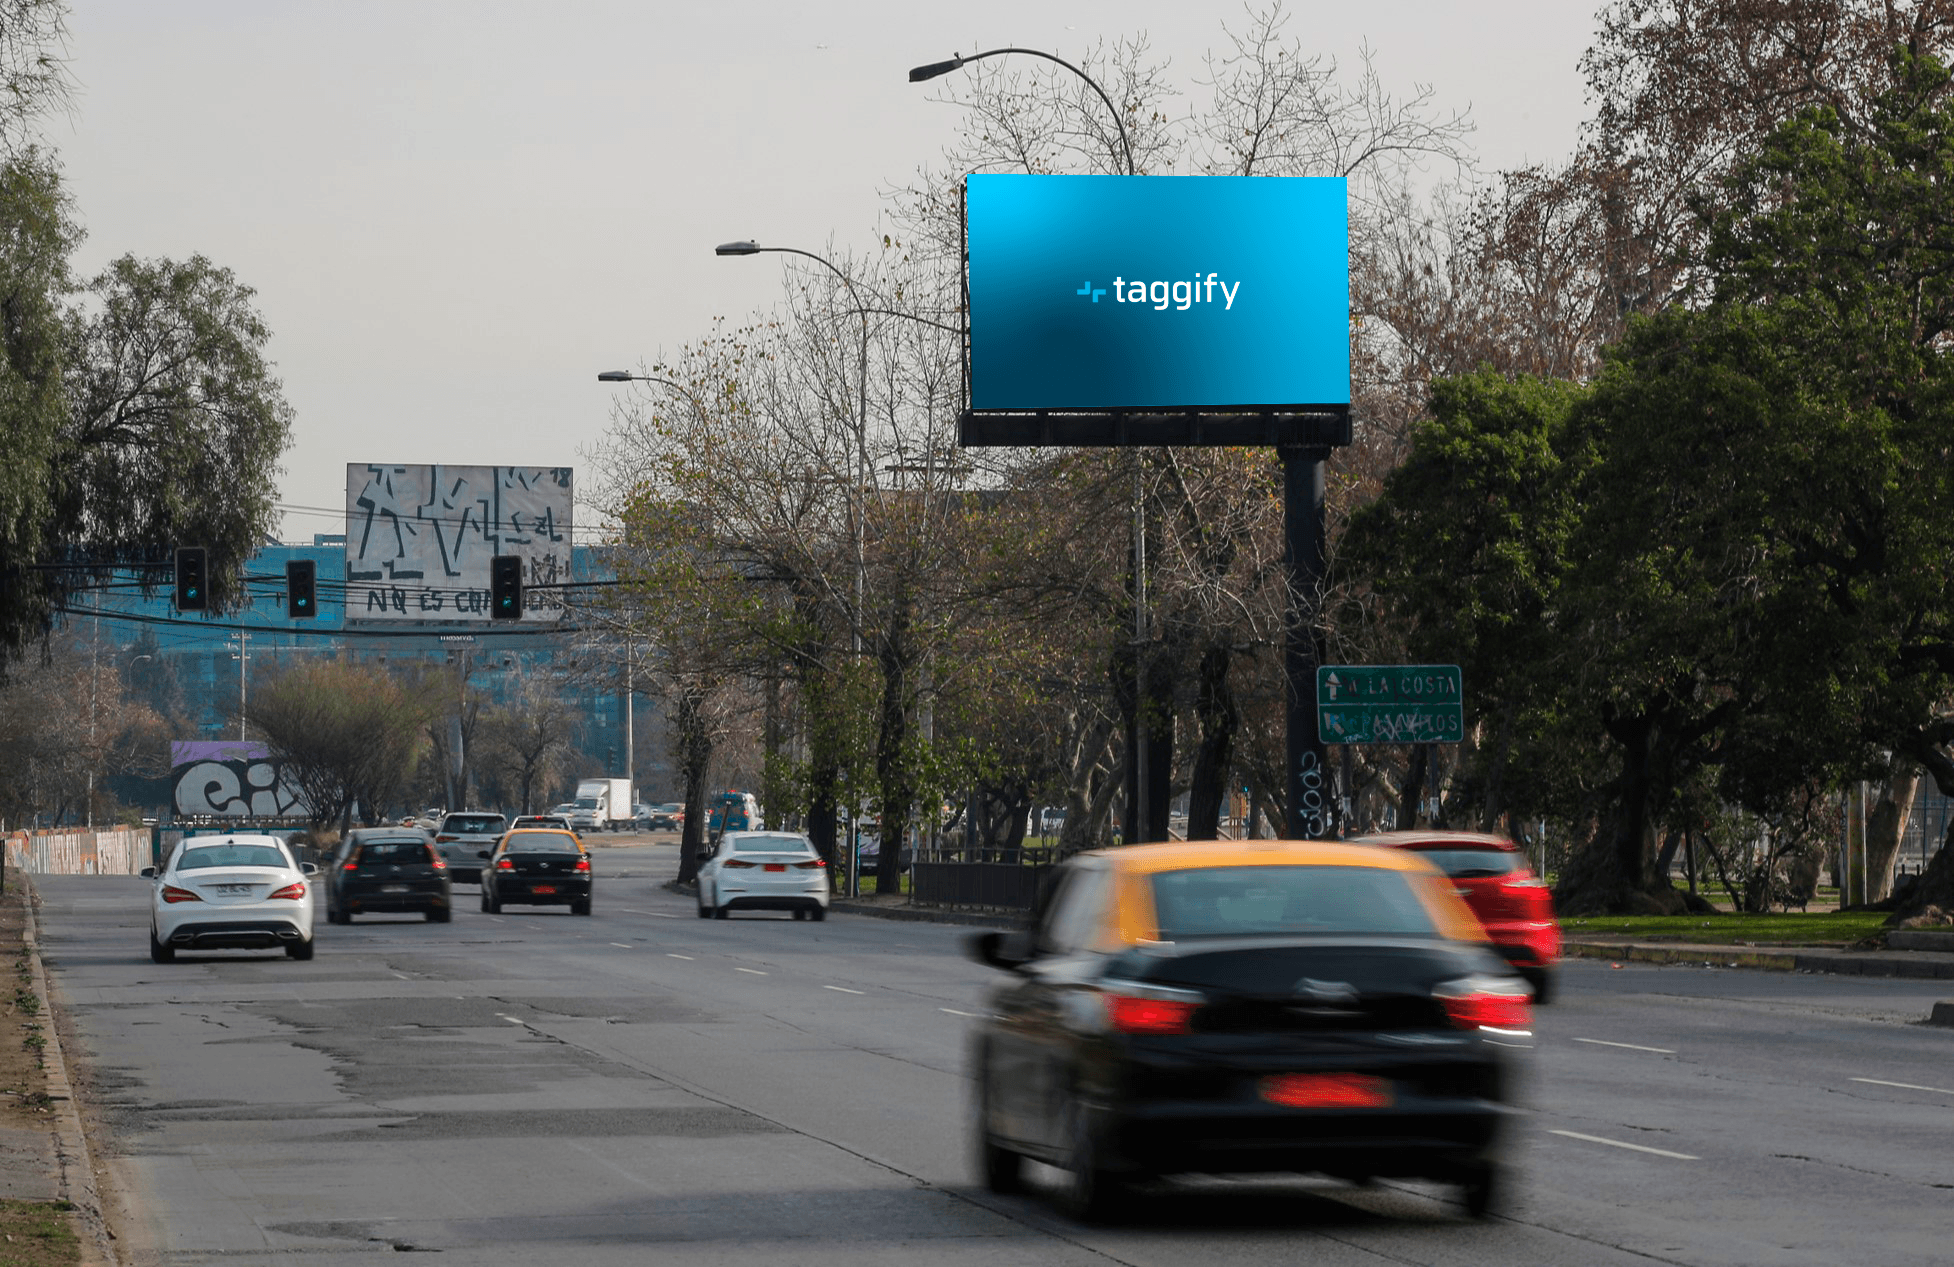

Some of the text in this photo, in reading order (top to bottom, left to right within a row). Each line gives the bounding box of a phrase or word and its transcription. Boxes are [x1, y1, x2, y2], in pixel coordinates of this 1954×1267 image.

[1113, 272, 1241, 311] taggify
[1368, 676, 1389, 694] LA
[1401, 676, 1456, 694] COSTA
